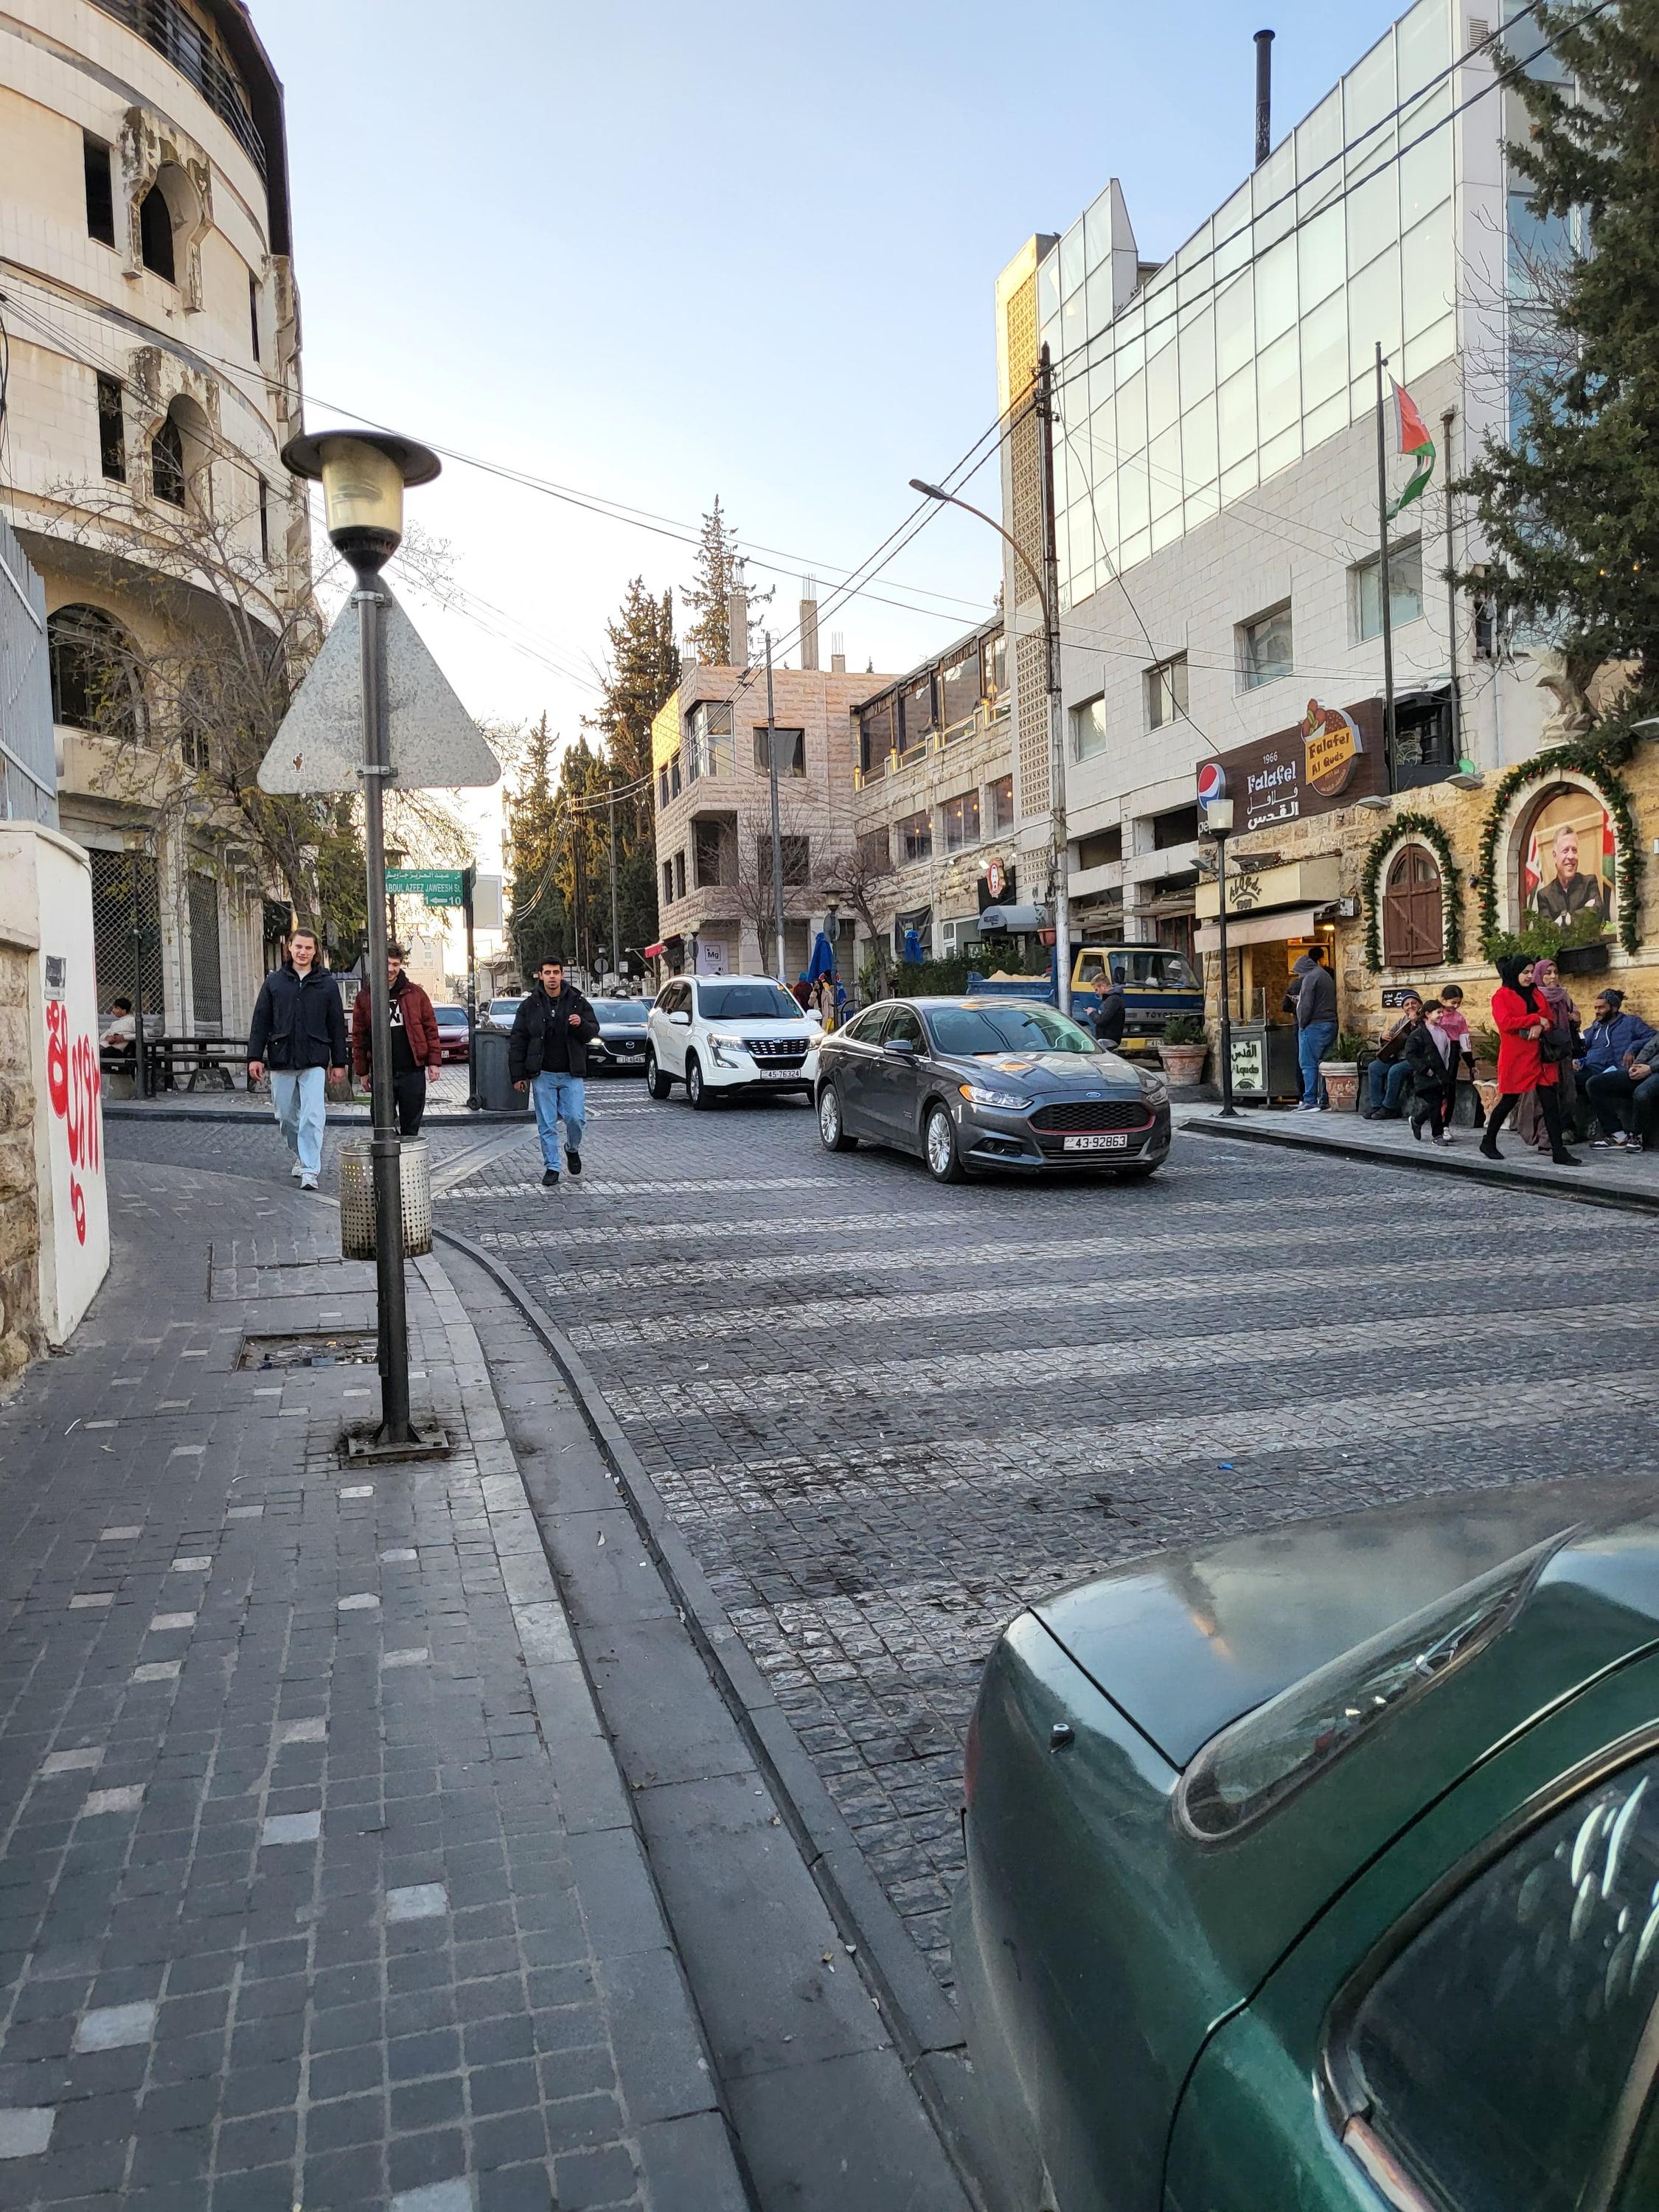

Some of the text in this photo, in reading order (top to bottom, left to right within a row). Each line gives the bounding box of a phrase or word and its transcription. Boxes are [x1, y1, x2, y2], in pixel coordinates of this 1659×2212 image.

[1308, 732, 1349, 759] Falafel
[1262, 751, 1279, 765] 1966
[1312, 760, 1321, 776] Al
[1324, 751, 1344, 768] Quds
[1247, 760, 1296, 795] Falafel
[1246, 783, 1298, 815] فلافل
[1247, 801, 1300, 830] القدس
[405, 883, 425, 892] AZEEZ
[425, 883, 453, 893] JAWEESH
[448, 896, 462, 905] 10
[707, 951, 719, 960] Mg
[768, 1070, 799, 1078] 45-76324
[1075, 1135, 1126, 1149] 43-92863
